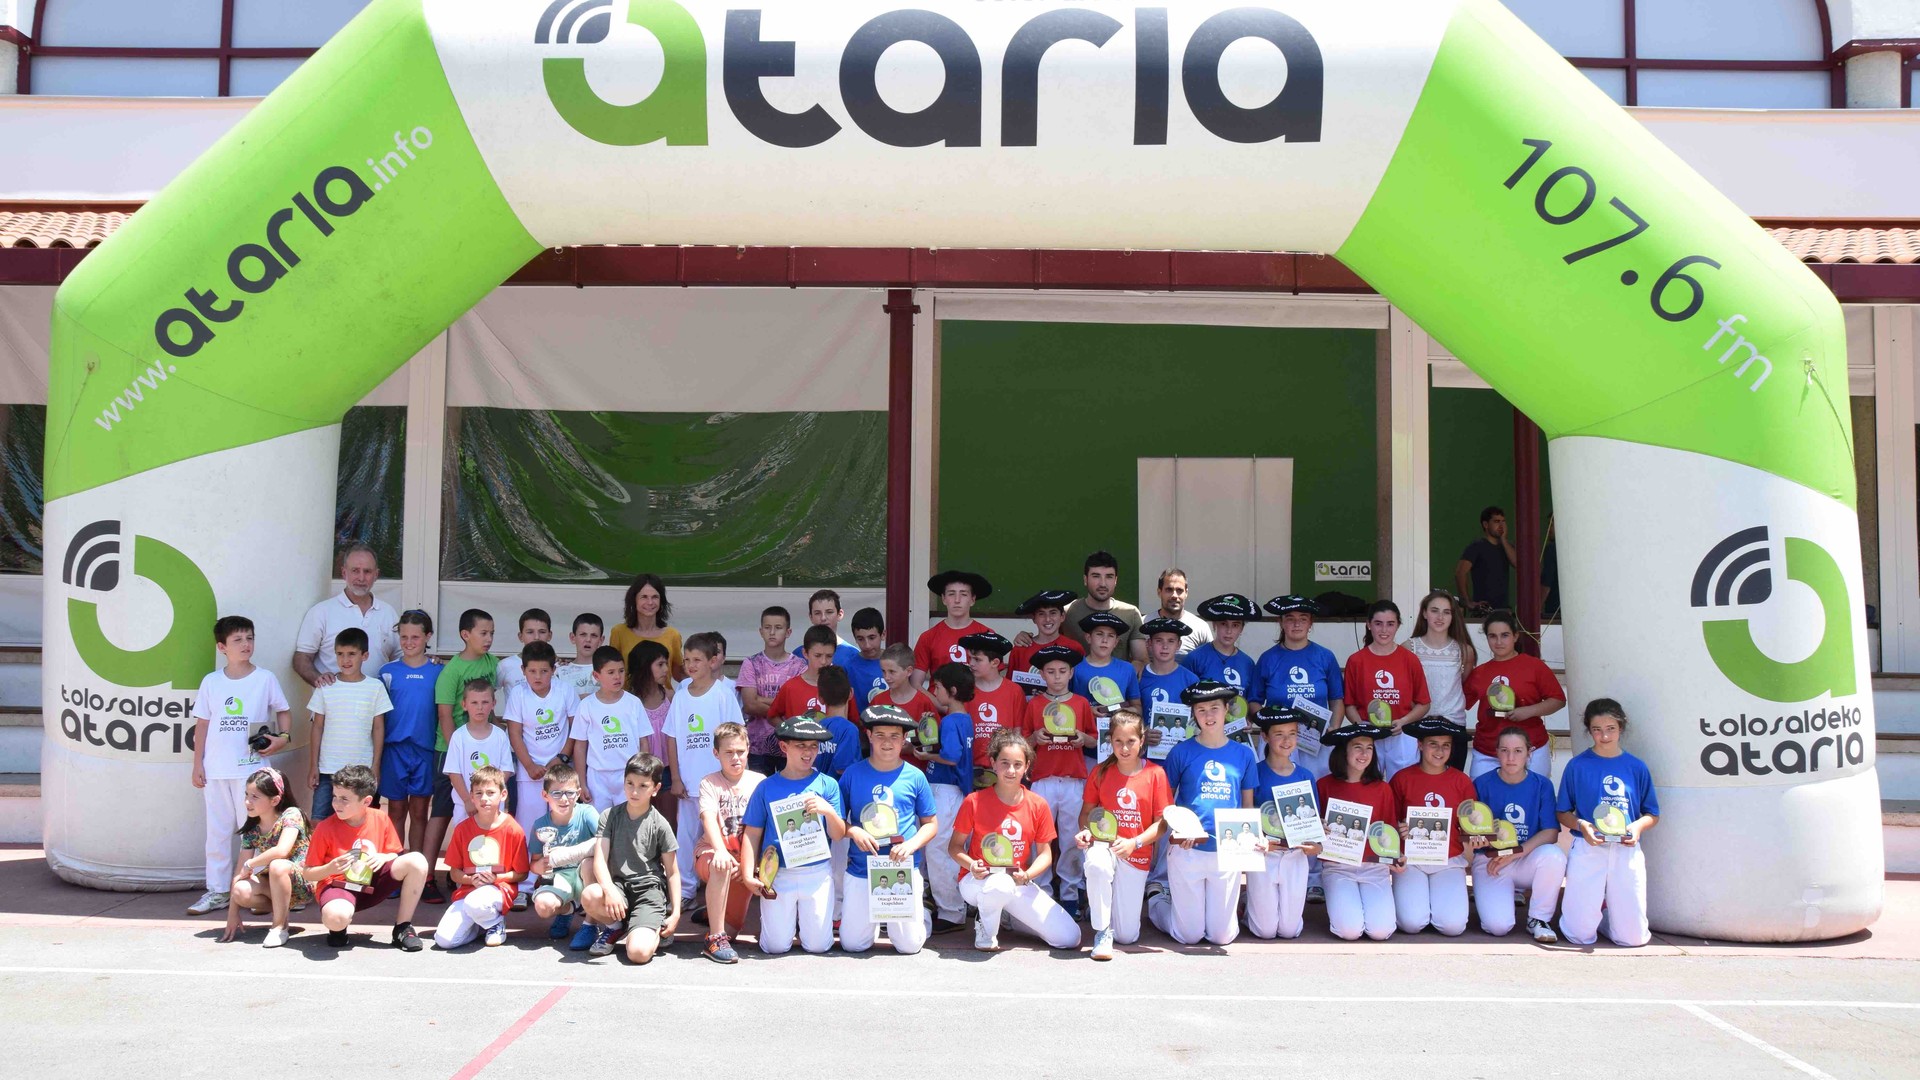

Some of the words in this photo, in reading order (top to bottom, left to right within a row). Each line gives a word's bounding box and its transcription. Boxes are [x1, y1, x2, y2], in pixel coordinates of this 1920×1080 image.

[534, 0, 1325, 148] ataria
[1503, 138, 1722, 322] 107.6
[1702, 314, 1773, 393] fm
[1318, 563, 1371, 576] ataria
[61, 684, 197, 719] tolosaldek
[1700, 705, 1862, 737] tolosaldeko
[603, 736, 629, 744] ataria
[1700, 732, 1864, 776] ataria
[1201, 786, 1232, 794] ataria
[871, 860, 901, 868] ataria
